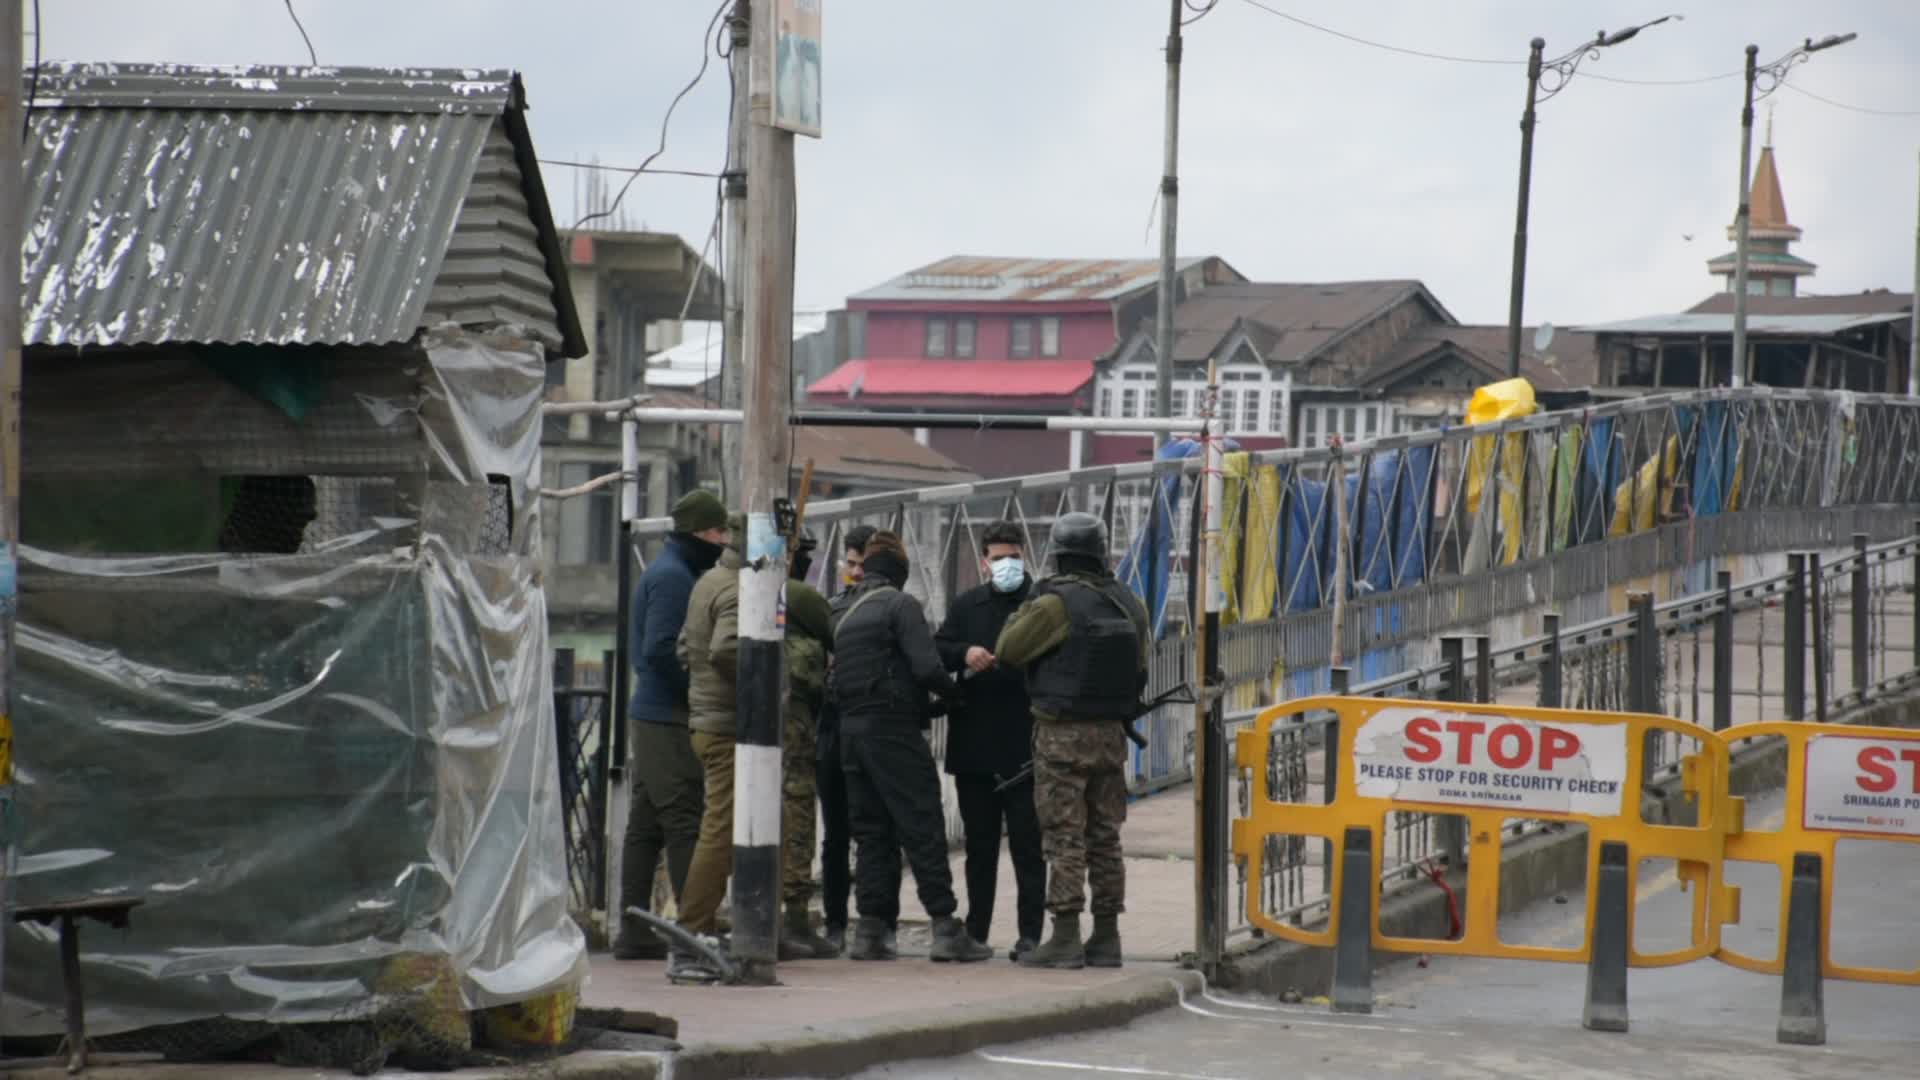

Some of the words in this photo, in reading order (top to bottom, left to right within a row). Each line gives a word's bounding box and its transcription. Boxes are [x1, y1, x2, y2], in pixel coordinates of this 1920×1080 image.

[1403, 717, 1580, 772] STOP
[1360, 764, 1412, 780] PLEASE
[1418, 768, 1455, 782] STOP
[1460, 770, 1488, 785] FOR
[1493, 774, 1563, 791] SECURITY
[1568, 779, 1618, 794] CHECK
[1843, 794, 1900, 808] SRINAGAR
